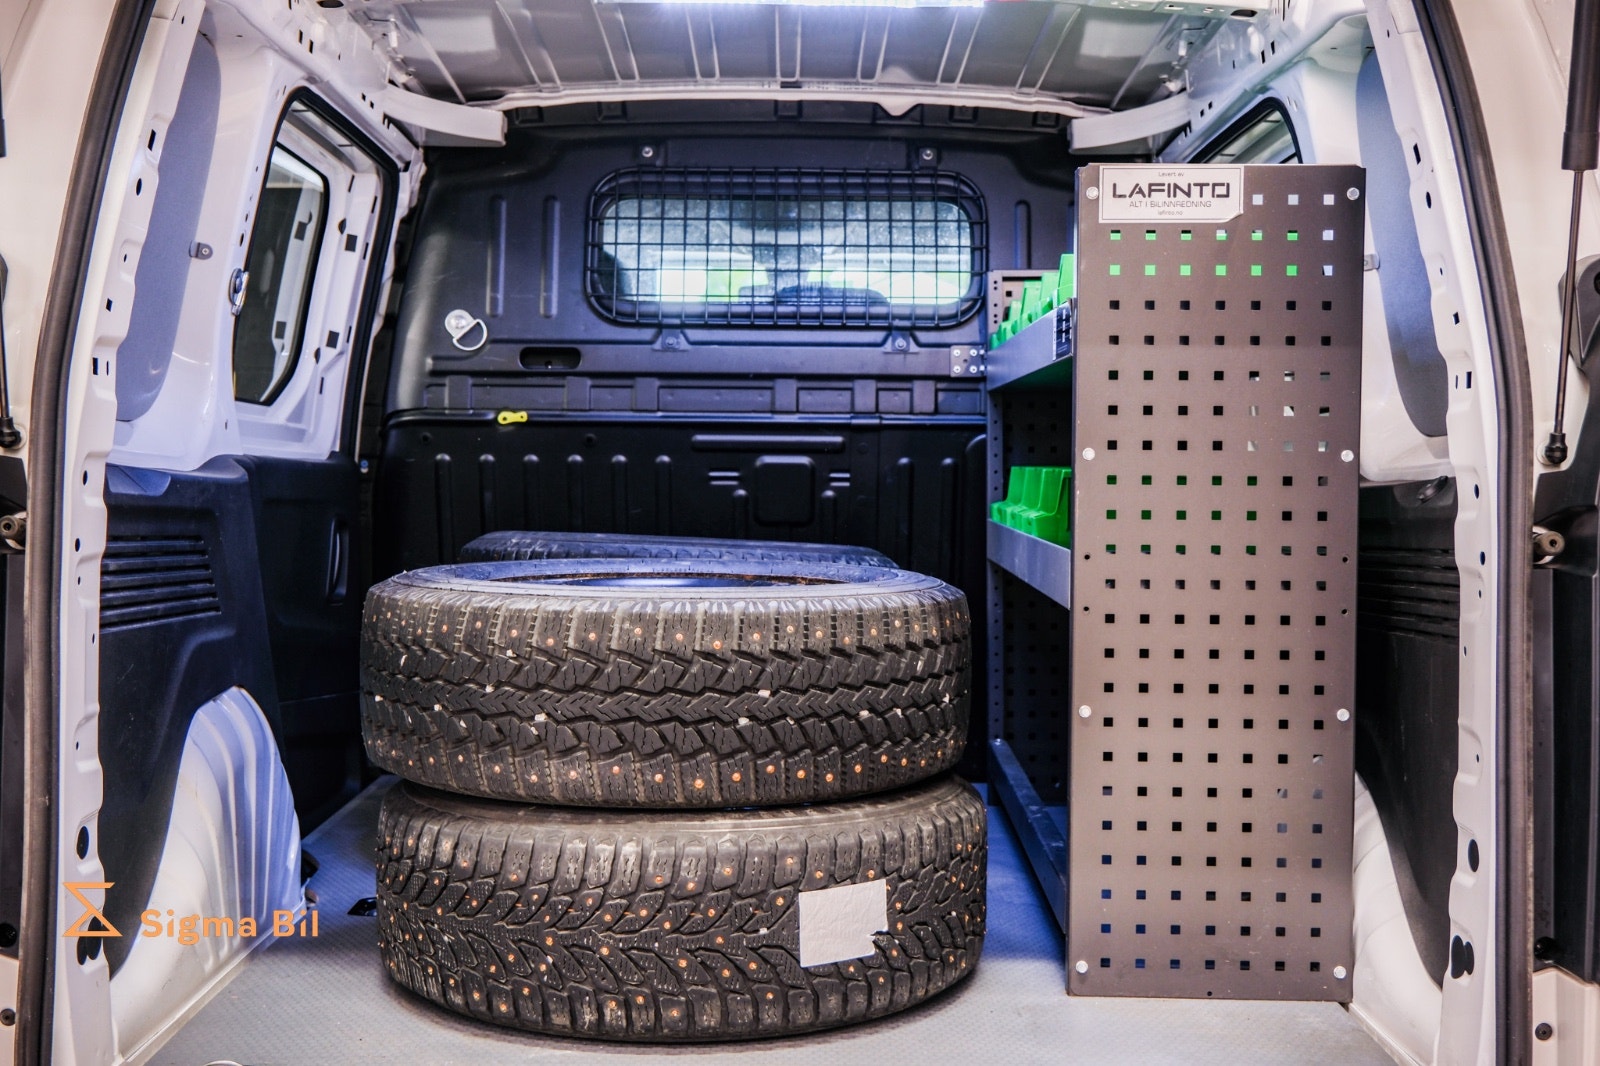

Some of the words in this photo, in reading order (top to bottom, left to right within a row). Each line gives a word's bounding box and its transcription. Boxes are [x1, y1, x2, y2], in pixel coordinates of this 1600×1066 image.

[1112, 182, 1230, 198] LAFINTO
[1129, 200, 1143, 208] ALT
[1150, 200, 1212, 208] BILINNREDNING
